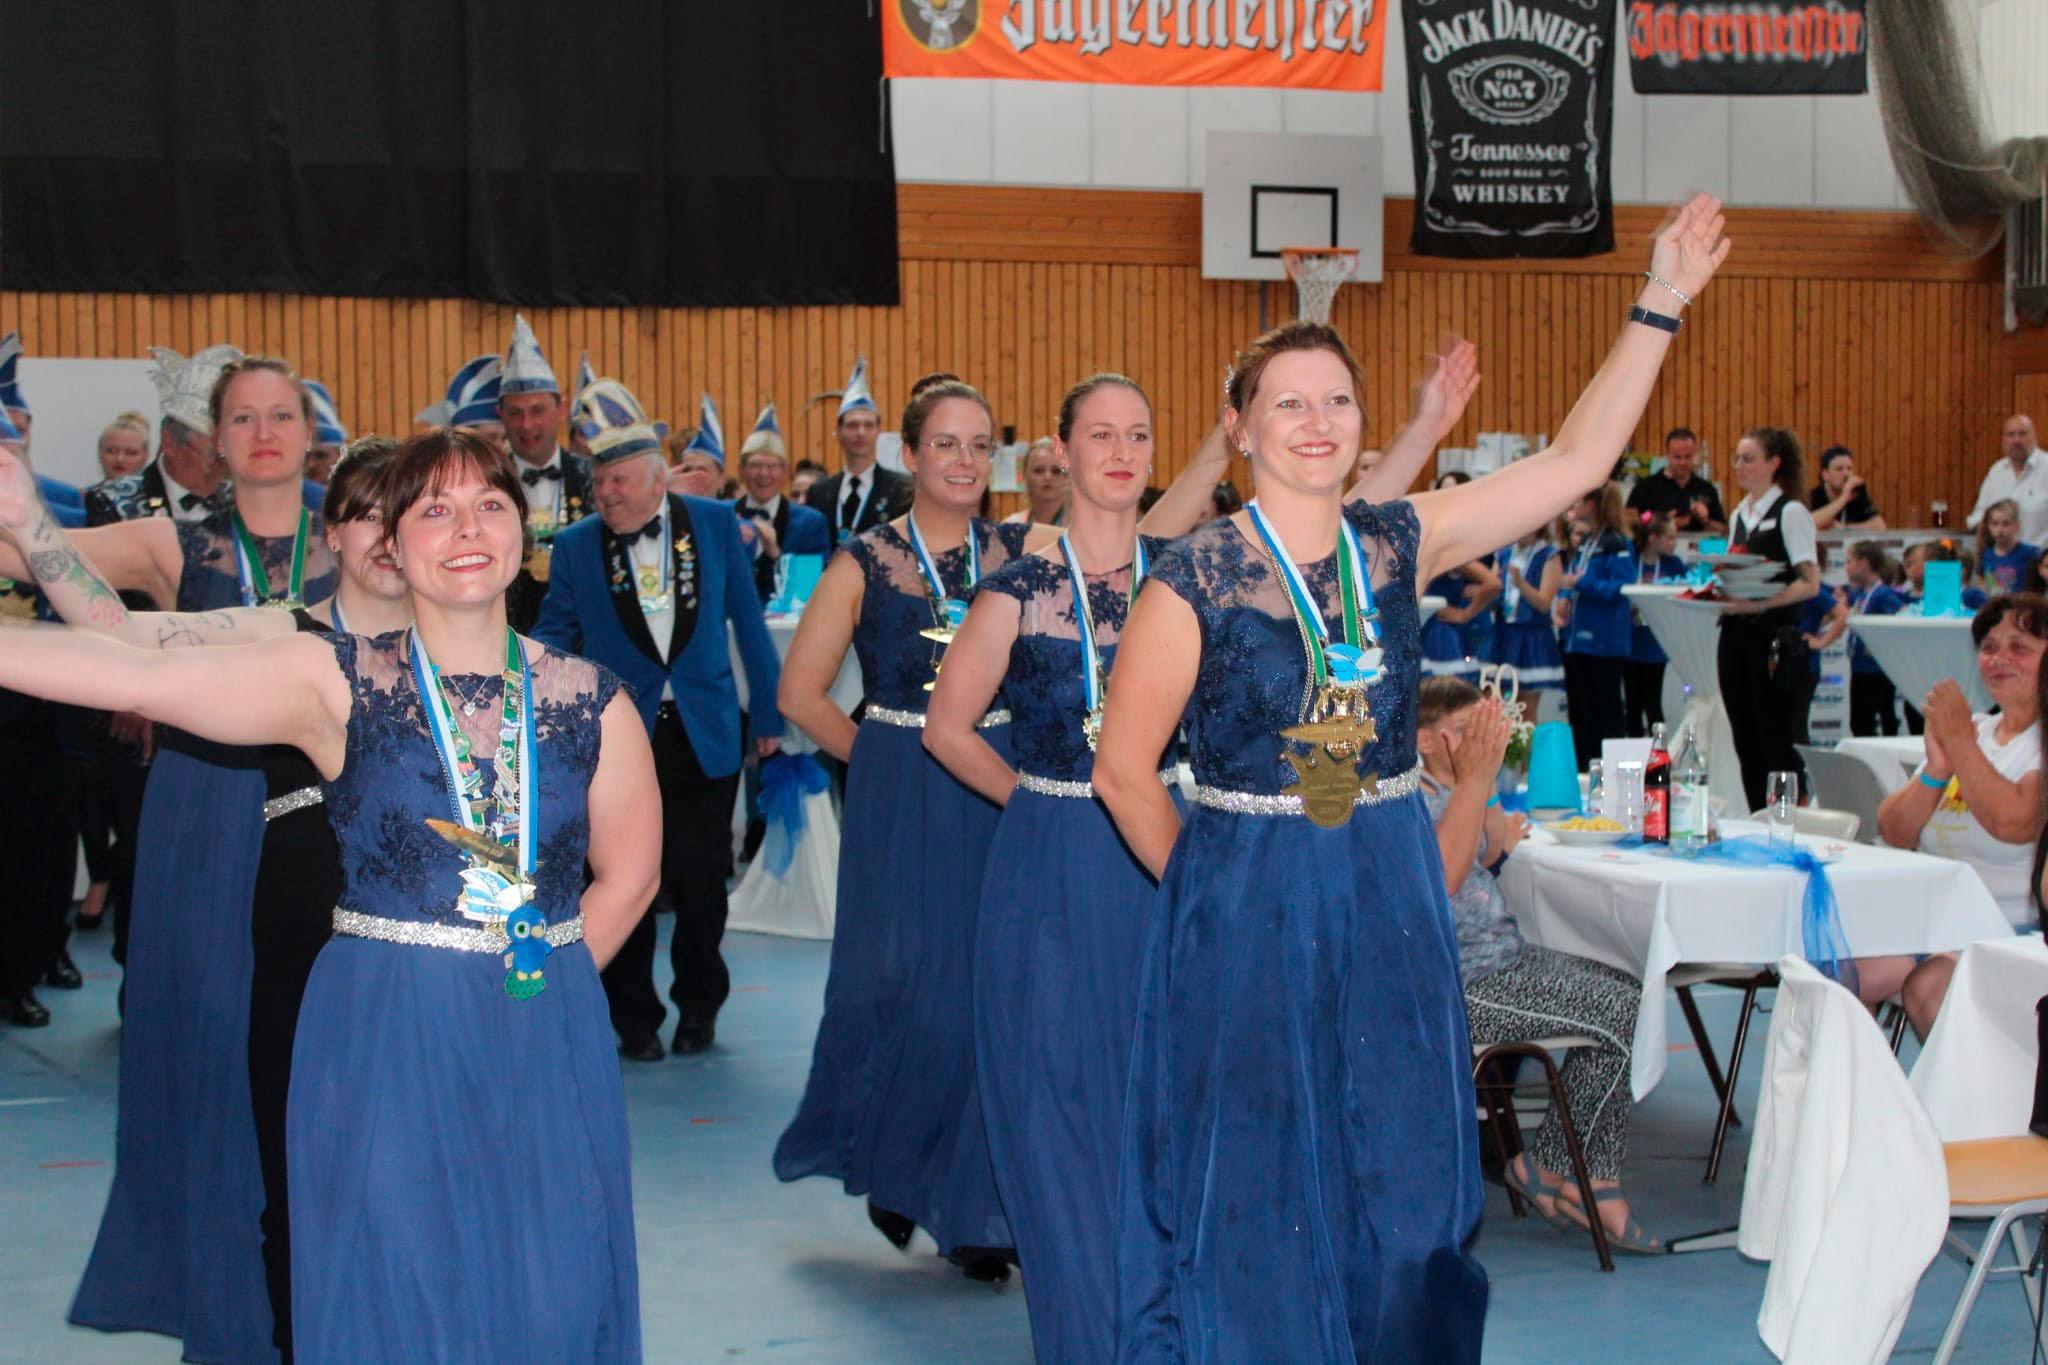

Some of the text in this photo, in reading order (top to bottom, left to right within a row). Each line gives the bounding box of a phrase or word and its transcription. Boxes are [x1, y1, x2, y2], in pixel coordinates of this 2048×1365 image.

[1419, 8, 1492, 64] JACK
[1495, 69, 1523, 80] Old
[1450, 133, 1571, 162] Tennessee
[1452, 184, 1571, 204] WHISKEY
